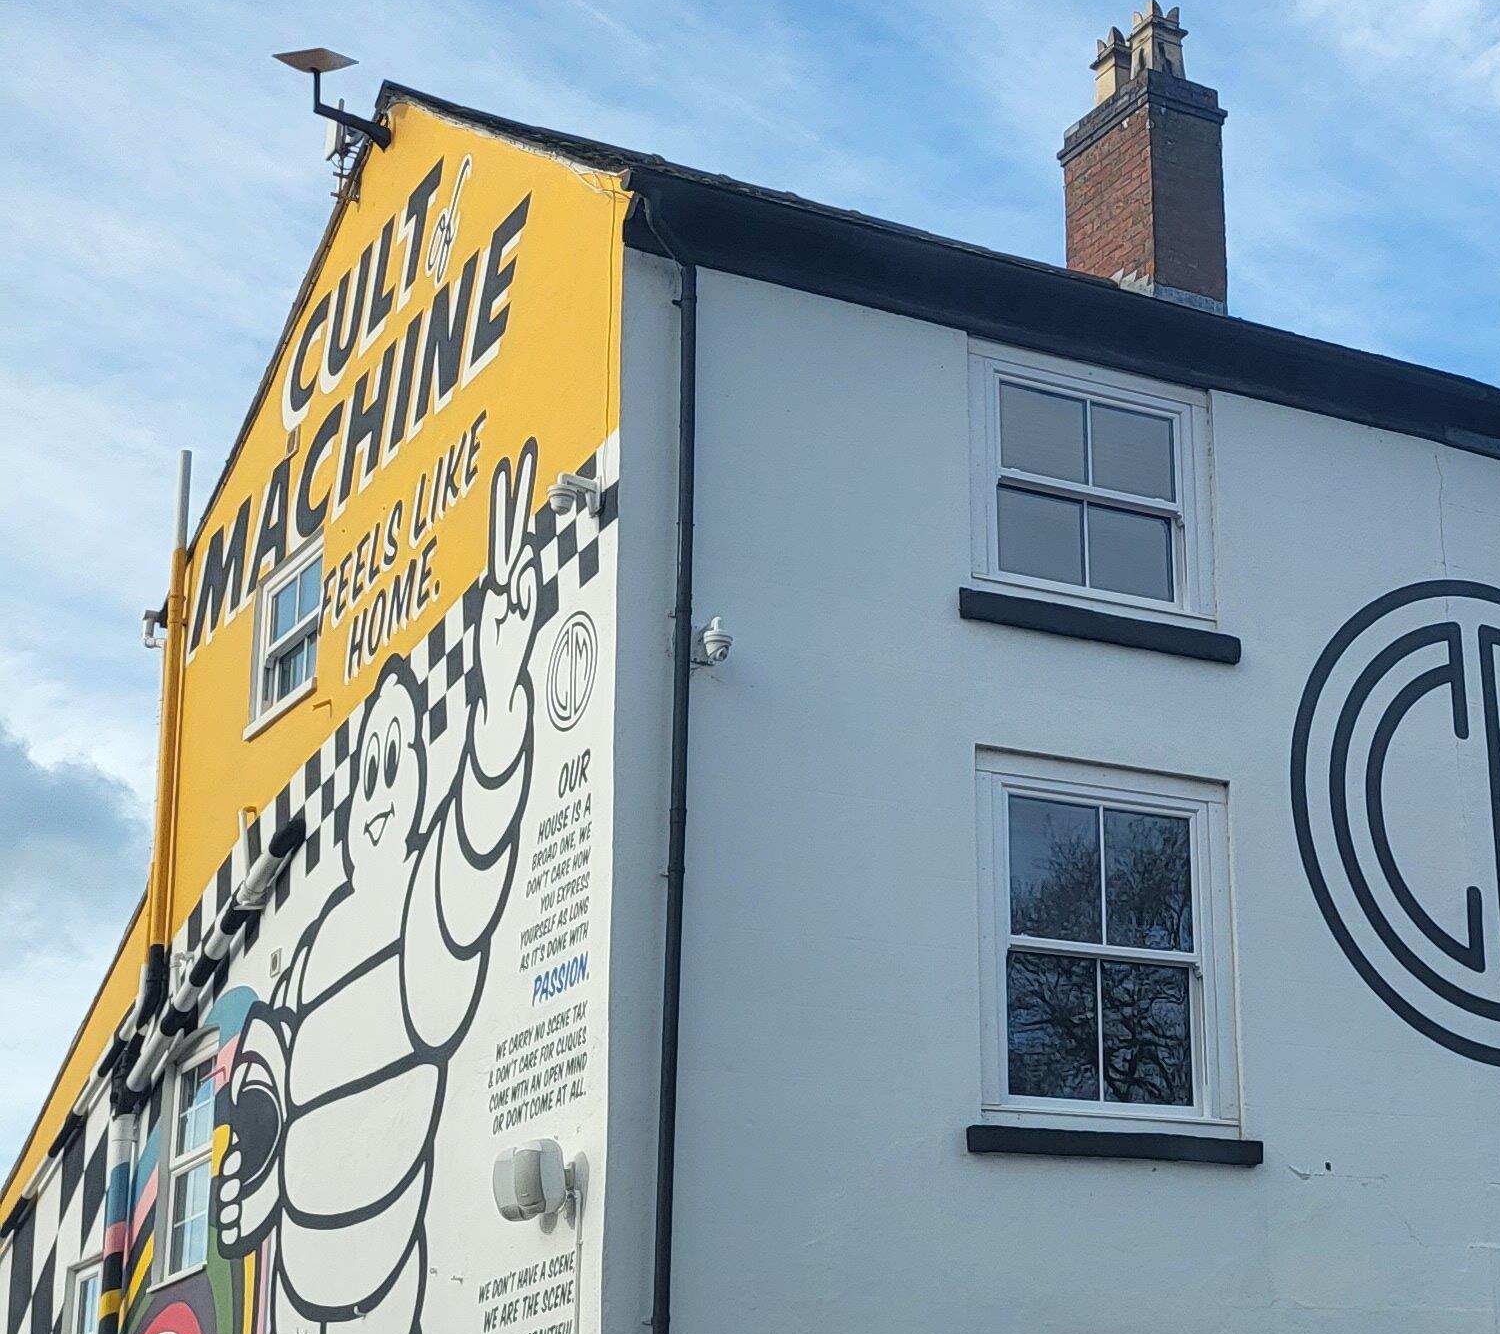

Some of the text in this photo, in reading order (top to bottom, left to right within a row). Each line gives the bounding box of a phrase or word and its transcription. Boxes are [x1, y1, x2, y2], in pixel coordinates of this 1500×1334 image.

[285, 154, 472, 425] CULT of
[186, 188, 533, 659] MACHINE
[318, 409, 487, 637] FEELS LIKE
[345, 534, 440, 683] HOME.
[558, 748, 591, 798] OUR
[537, 793, 592, 844] HOUSE IS A
[526, 846, 591, 898] DON'T CARE HOW
[531, 821, 592, 872] BROAD ONE, WE
[540, 871, 590, 914] YOU EXPRESS
[519, 920, 589, 973] AS IT'S DONE WITH
[520, 896, 590, 950] YOURSELF AS LONG
[531, 951, 590, 1007] PASSION.
[495, 1059, 518, 1085] DON'T
[519, 1049, 539, 1074] CARE
[539, 1041, 554, 1065] FOR
[556, 1026, 587, 1056] CLIQUES
[496, 1000, 588, 1062] WE CARRY NO SCENE TAX
[489, 1052, 587, 1113] COME WITH AN OPEN MIND
[493, 1077, 587, 1135] OR DON'T COME AT ALL.
[478, 1281, 491, 1304] WE
[492, 1271, 517, 1299] DON'T
[517, 1264, 539, 1290] HAVE
[539, 1261, 546, 1282] A
[483, 1280, 574, 1333] WE ARE THE SCENE.
